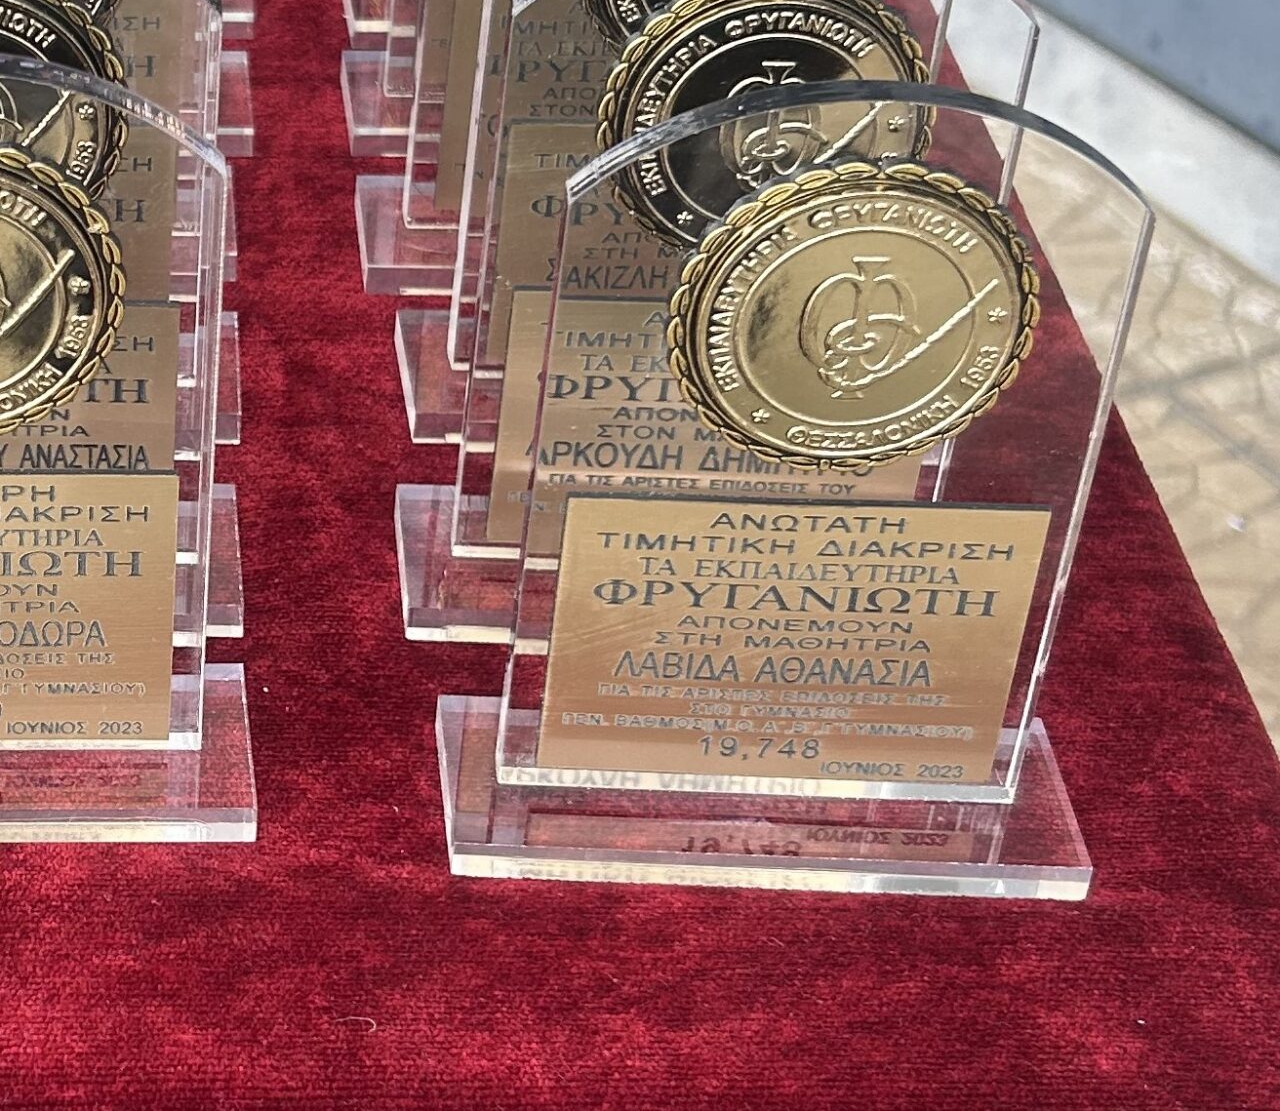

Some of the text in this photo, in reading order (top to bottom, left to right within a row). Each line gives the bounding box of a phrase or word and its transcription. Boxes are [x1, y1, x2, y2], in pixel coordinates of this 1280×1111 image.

[580, 354, 614, 372] ΤΑ
[960, 345, 1002, 390] 1953
[596, 425, 676, 441] ΣΤΟΝ
[20, 443, 150, 470] ΑΝΑΣΤΑΣΙΑ
[622, 476, 701, 489] ΑΡΙΣΤΕΣ
[709, 512, 907, 535] ΑΝΩΤΑΤΗ
[597, 532, 1015, 562] ΤΙΜΗΤΙΚΗ ΔΙΑΚΡΙΣΗ
[638, 557, 960, 585] ΤΑ ΕΚΠΑΙΔΕΥΤΗΡΙΑ
[592, 578, 1000, 618] ΦΡΥΓΑΝΙΩΤΗ
[676, 615, 913, 634] ΑΠΟΝΕΜΟΥΝ
[652, 632, 932, 653] ΣΤΗ ΜΑΘΗΤΡΙΑ
[77, 652, 115, 665] ΤΗΣ
[612, 651, 932, 688] ΛΑΒΙΔΑ ΑΘΑΝΑΣΙΑ
[597, 683, 631, 697] ΓΙΑ
[641, 685, 673, 699] ΤΙΣ
[7, 720, 144, 735] ΙΟΥΝΙΟΣ 2023
[697, 736, 822, 761] 19,748
[820, 760, 964, 779] ΙΟΥΝΙΟΣ 2023
